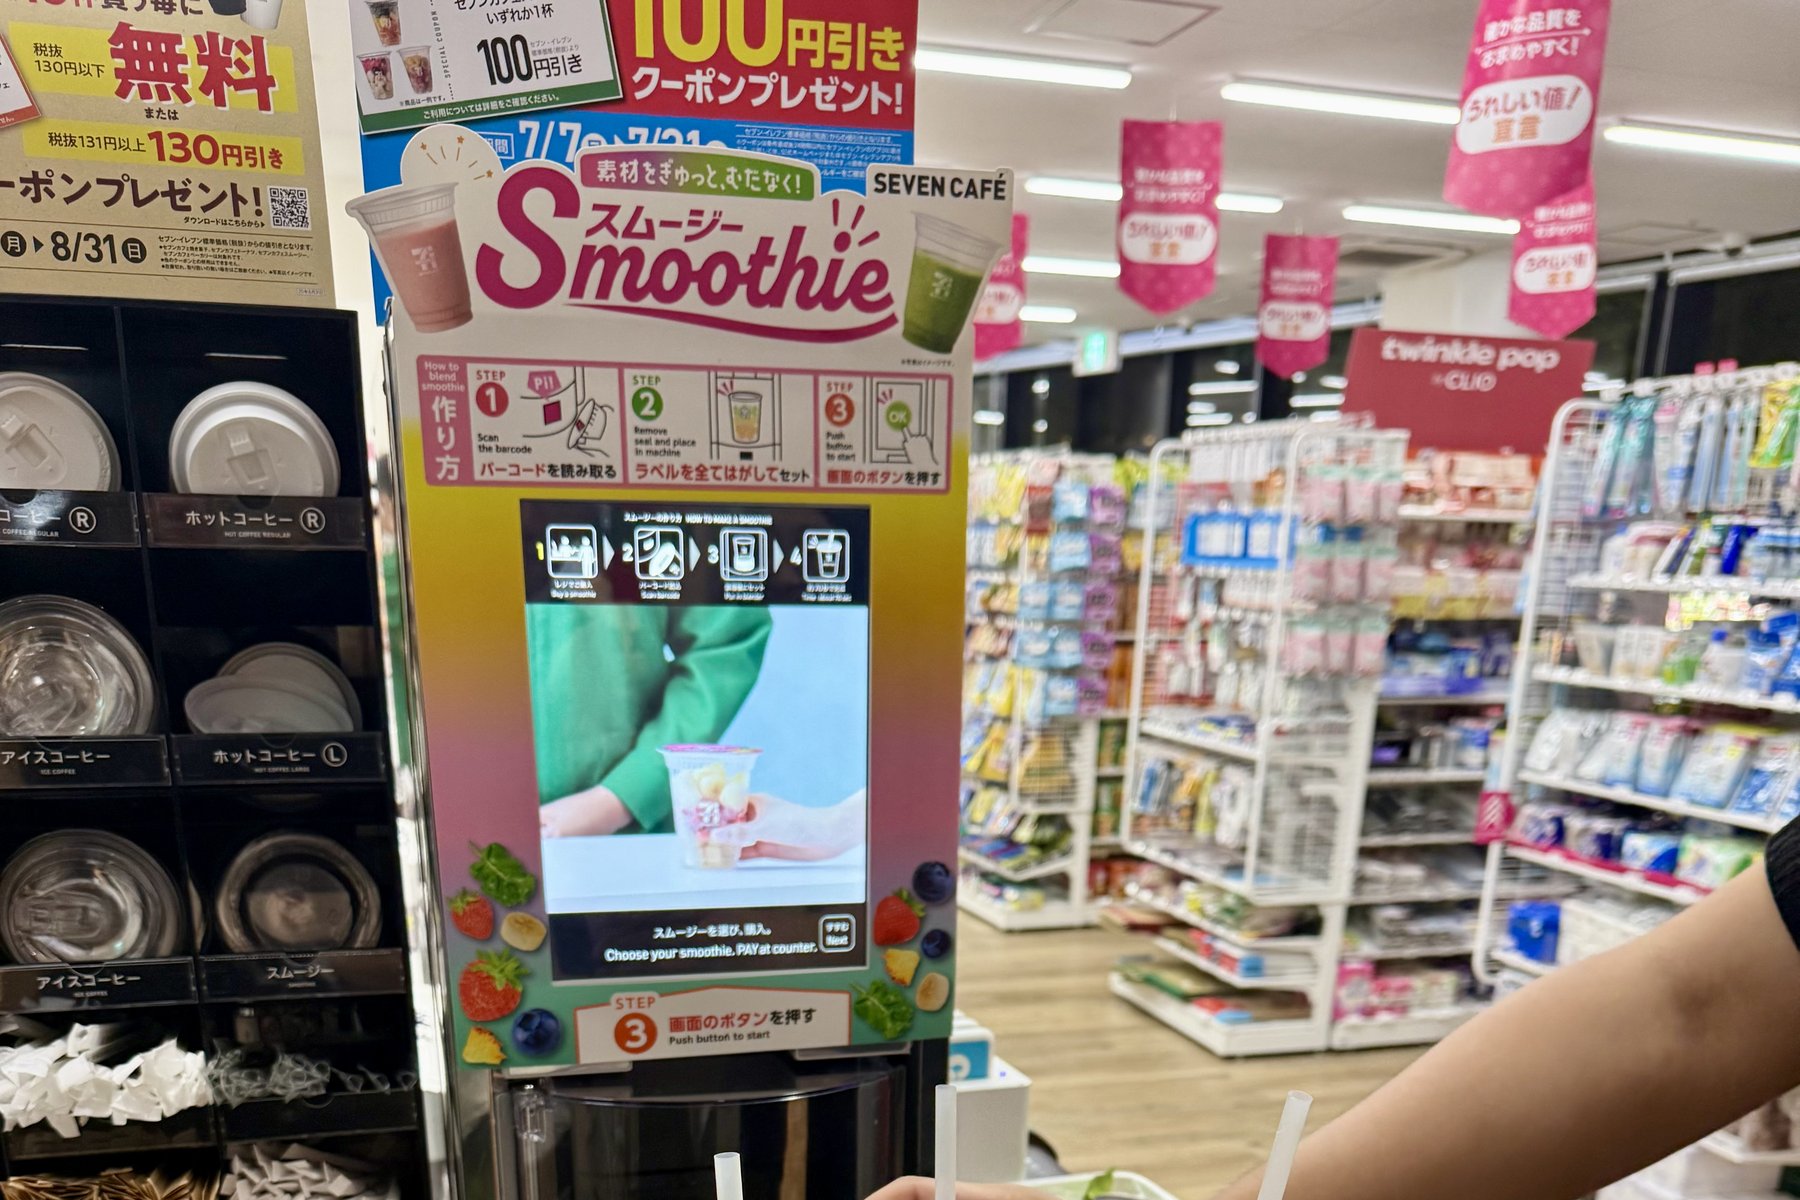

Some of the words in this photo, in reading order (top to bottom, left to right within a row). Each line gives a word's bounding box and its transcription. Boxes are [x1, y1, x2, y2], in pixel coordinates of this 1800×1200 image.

[486, 3, 554, 24] いずれか1杯
[431, 11, 443, 42] COUPON
[634, 0, 905, 72] 100円引き
[33, 42, 63, 59] 税抜
[108, 21, 277, 112] 無料
[439, 46, 451, 78] SPECIAL
[477, 34, 583, 86] 100円引き
[34, 60, 105, 78] 130円以下
[632, 67, 903, 115] クーポンプレゼント!
[144, 107, 179, 121] または
[48, 131, 147, 153] 税抜131円以上
[148, 130, 283, 170] 130円引き
[596, 158, 801, 195] 素材をぎゅっと、むだなく!
[874, 172, 945, 198] SEVEN
[950, 172, 1007, 201] CAFÉ
[585, 203, 743, 243] スムージー
[51, 231, 117, 264] 8/31
[476, 166, 895, 315] Smoothie
[1381, 335, 1497, 366] twinkle
[1496, 347, 1561, 374] pop
[424, 361, 447, 371] How
[449, 362, 460, 371] to
[429, 371, 457, 381] blend
[476, 370, 506, 381] STEP
[633, 375, 661, 386] STEP
[421, 382, 466, 392] smoothie
[826, 382, 853, 392] STEP
[888, 410, 907, 424] OK
[432, 395, 461, 481] 作り方
[477, 433, 499, 442] Scan
[634, 426, 668, 435] Remove
[826, 432, 845, 440] Push
[478, 445, 493, 453] the
[496, 445, 532, 454] barcode
[634, 437, 652, 446] seal
[655, 438, 671, 446] and
[673, 438, 696, 448] place
[826, 442, 853, 451] button
[635, 448, 643, 456] in
[646, 448, 681, 457] machine
[826, 453, 836, 461] to
[838, 453, 855, 462] start
[480, 462, 617, 479] バーコードを読み取る
[635, 462, 811, 484] ラベルを全てはがしてセット
[827, 469, 941, 486] 画面のボタンを押す
[186, 510, 293, 527] ホットコーヒー
[536, 541, 544, 560] 1
[622, 542, 633, 562] 2
[708, 544, 719, 564] 3
[1, 750, 111, 765] アイスコーヒー
[213, 748, 316, 764] ホットコーヒー
[605, 946, 650, 962] Choose
[650, 945, 678, 962] your
[737, 941, 759, 956] PAY
[759, 942, 771, 955] at
[266, 964, 335, 981] スムージー
[36, 973, 142, 990] アイスコーヒー
[616, 996, 656, 1010] STEP
[669, 1008, 816, 1034] 画面のボタンを押す
[669, 1035, 694, 1045] Push
[697, 1033, 730, 1044] button
[733, 1032, 744, 1041] to
[747, 1030, 770, 1041] start
